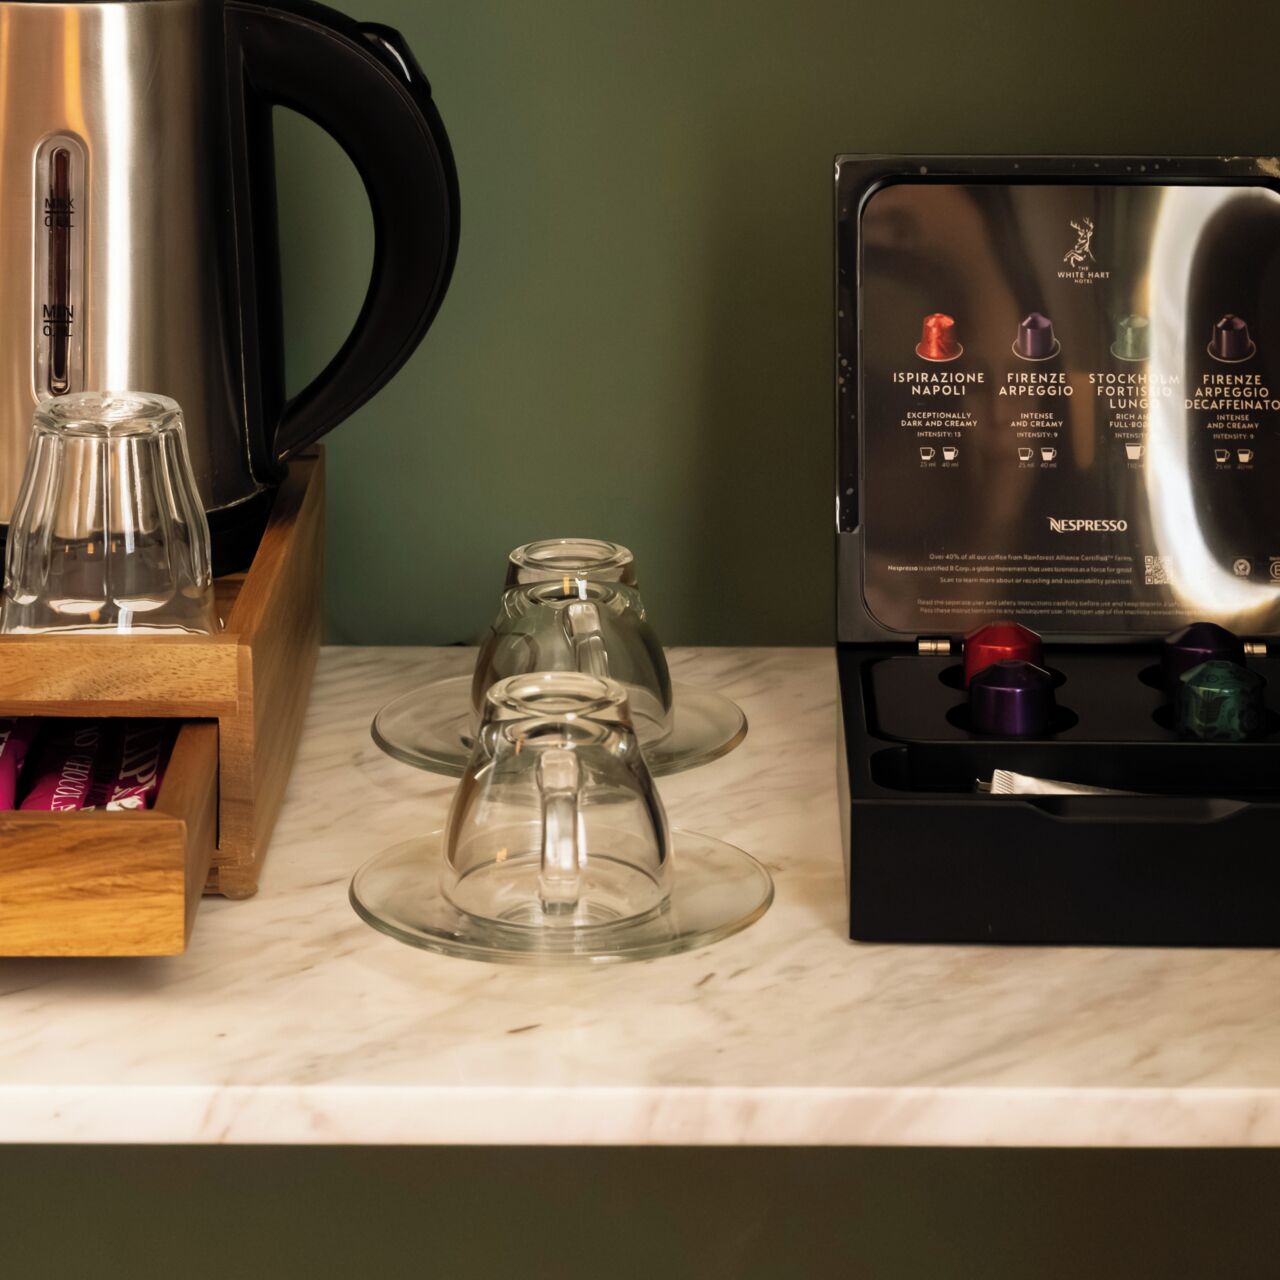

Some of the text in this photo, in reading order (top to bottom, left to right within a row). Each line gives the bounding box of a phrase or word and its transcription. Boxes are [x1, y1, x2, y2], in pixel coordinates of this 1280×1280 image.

[1057, 271, 1110, 279] WHITE HART
[893, 372, 985, 383] ISPIRAZIONE
[1007, 373, 1066, 383] FIRENZE
[1089, 373, 1180, 384] STOCKHOLM
[1203, 374, 1262, 385] FIRENZE
[911, 385, 966, 395] NAPOLI
[999, 386, 1073, 396] ARPEGGIO
[1195, 387, 1269, 398] ARPEGGIO
[1110, 399, 1160, 409] LUNGO
[1185, 399, 1280, 410] DECAFFEINATO
[1020, 412, 1054, 420] INTENSE
[1046, 516, 1128, 534] NESPRESSO
[888, 565, 919, 573] Nespresso
